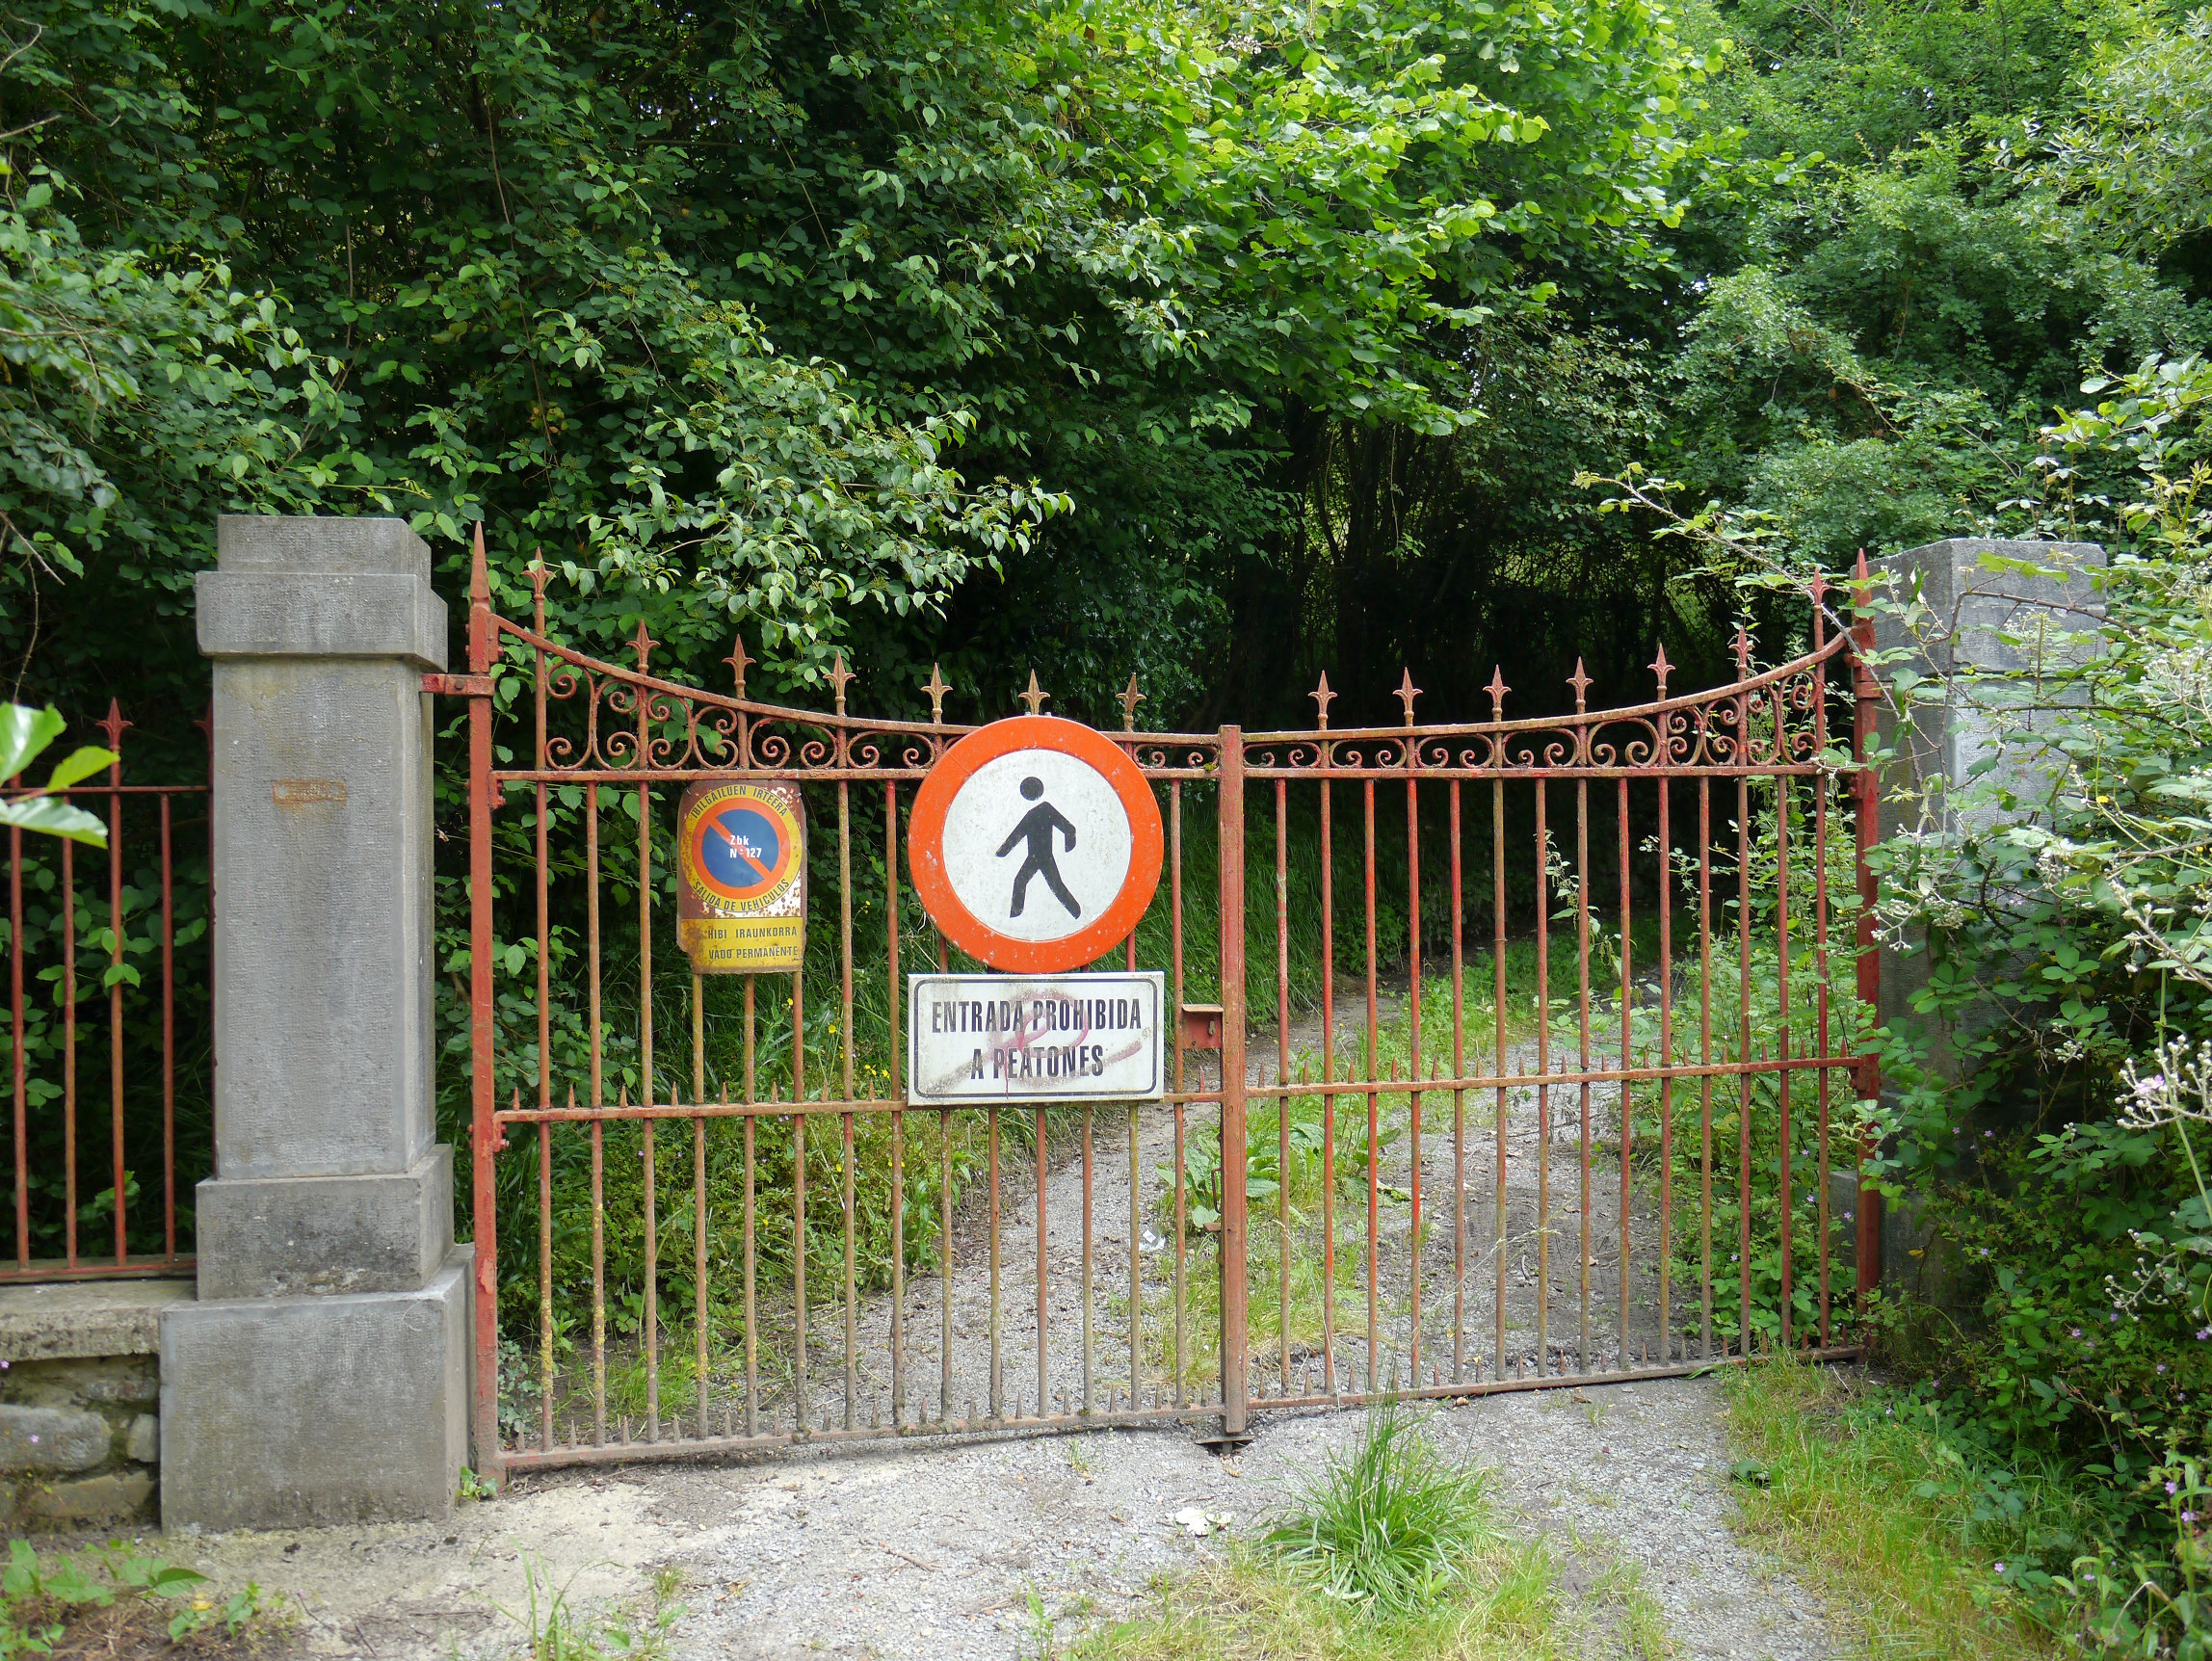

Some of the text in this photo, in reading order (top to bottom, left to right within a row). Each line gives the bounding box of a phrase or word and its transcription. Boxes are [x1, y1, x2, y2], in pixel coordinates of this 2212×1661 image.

[691, 785, 788, 819] IBILGAILUEN IRTEERA
[730, 834, 750, 846] Zbk
[746, 847, 762, 858] 127
[693, 878, 789, 911] SALIDA DE VEHICULOS
[735, 926, 798, 938] IRAUNKORRA
[708, 946, 799, 960] VADO PERMANENTE
[932, 998, 1142, 1034] ENTRADA PROHIBIDA
[970, 1044, 1104, 1080] A PEATONES
